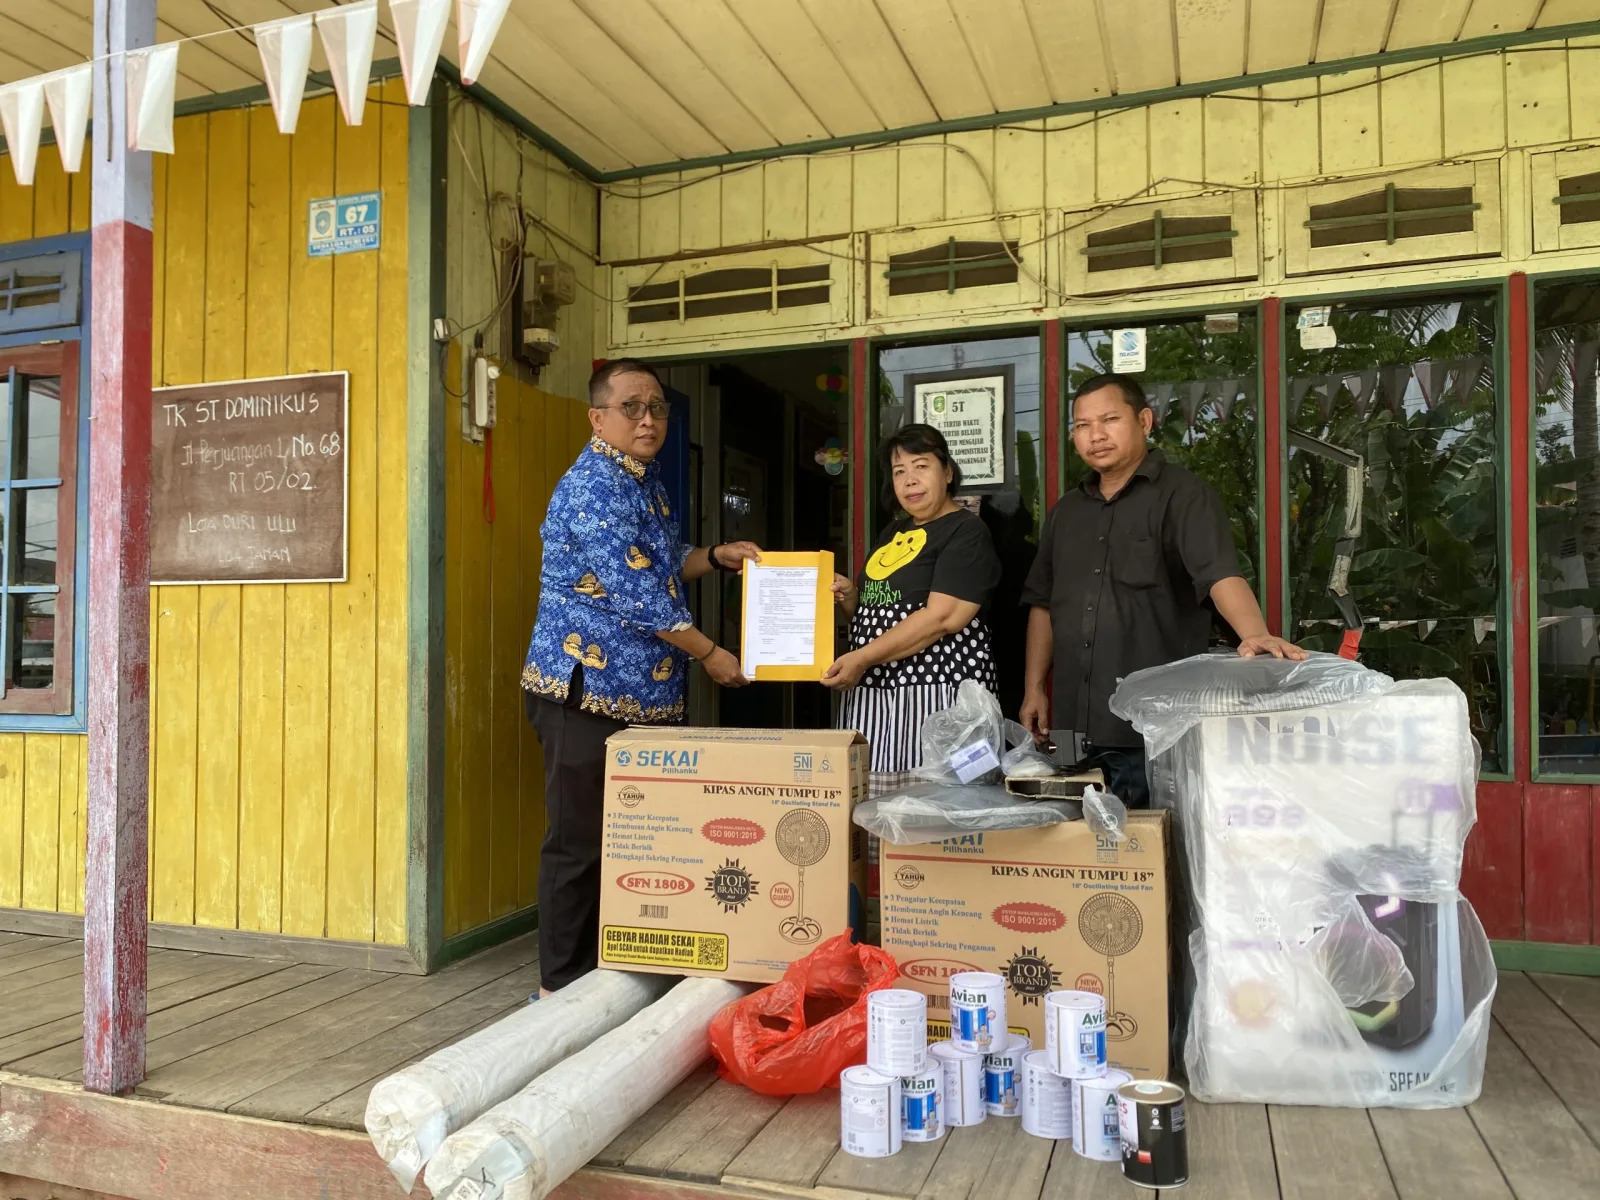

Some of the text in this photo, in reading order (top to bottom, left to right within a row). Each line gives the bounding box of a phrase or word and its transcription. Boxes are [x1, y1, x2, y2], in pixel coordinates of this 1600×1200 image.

[345, 204, 368, 224] 67
[163, 404, 187, 427] TK
[225, 392, 319, 420] DOMINIKUS
[952, 401, 965, 413] 5T
[943, 420, 961, 428] TERTIB
[961, 428, 982, 436] BELAJAR
[959, 438, 984, 446] MENGAJAR
[200, 438, 272, 470] Perjuangan
[319, 431, 341, 456] 68
[954, 447, 988, 455] ADMINISTRASI
[229, 471, 245, 494] RT
[864, 580, 891, 593] HAVE A
[859, 592, 879, 605] HAPPY
[636, 750, 699, 767] SEKAI
[794, 754, 813, 769] SNI
[703, 785, 736, 795] KIPAS
[738, 786, 775, 797] ANGIN
[778, 787, 820, 799] TUMPU
[618, 812, 645, 821] Pengatur
[647, 813, 679, 822] Kecepatan
[612, 822, 693, 834] Hembusan Angin Kencang
[723, 830, 757, 839] 9001:2015
[631, 843, 653, 851] Berisik
[943, 845, 984, 854] Pilihanku
[611, 852, 704, 864] Dilengkapi Sekring Pengaman
[900, 873, 925, 881] TAHUN
[991, 865, 1029, 877] KIPAS
[1032, 867, 1075, 879] ANGIN
[1078, 869, 1129, 881] TUMPU
[627, 877, 686, 890] SFN 1808
[717, 874, 746, 887] TOP
[1083, 883, 1119, 891] Oscillating
[717, 885, 747, 895] BRAND
[896, 894, 927, 903] Pengatur
[929, 896, 966, 906] Kecepatan
[890, 905, 982, 919] Hembusan Angin Kencang
[891, 916, 939, 926] Hemat Listrik
[1002, 914, 1057, 926] ISO 9001:2015
[891, 926, 938, 936] Tidak Berisik
[606, 930, 695, 948] GEBYAR HADIAH SEKAI
[891, 937, 996, 952] Dilengkapi Sekring Pengaman
[619, 943, 633, 952] SCAN
[649, 946, 674, 956] dapatkan
[675, 948, 694, 957] Hadiah
[910, 965, 976, 977] SFN 18
[1013, 963, 1046, 978] TOP
[1013, 976, 1048, 986] BRAND
[951, 987, 987, 1003] Avian
[1082, 1009, 1106, 1025] Avi
[927, 1025, 952, 1038] HADI
[984, 1053, 1013, 1067] vian
[900, 1077, 935, 1090] vian
